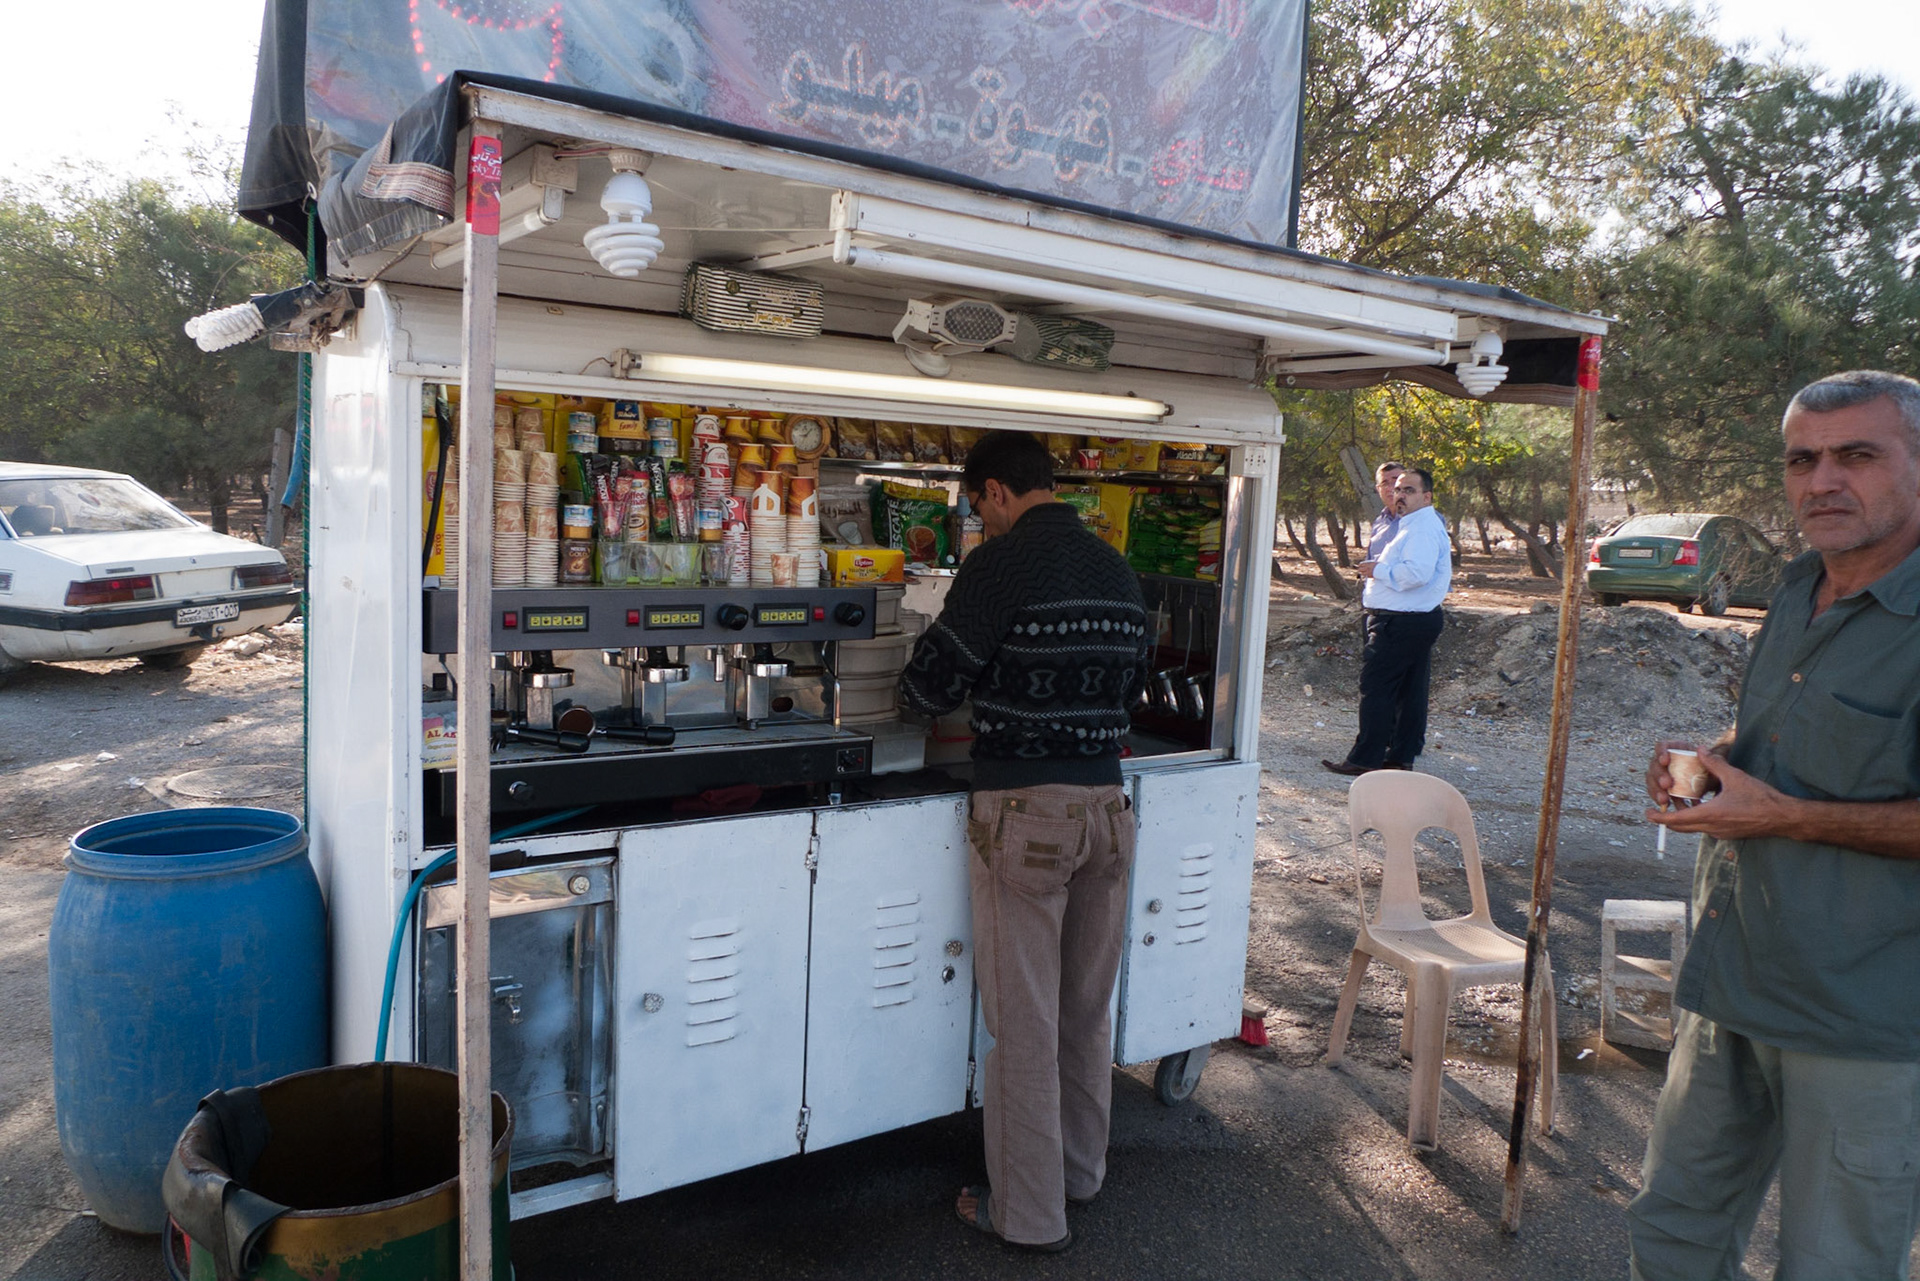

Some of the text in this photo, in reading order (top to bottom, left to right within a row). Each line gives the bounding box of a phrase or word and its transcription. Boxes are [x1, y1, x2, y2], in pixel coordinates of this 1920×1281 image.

[768, 42, 1251, 203] شاي قهوة ميلو
[887, 499, 903, 549] ESCAFÉ
[855, 560, 873, 568] Lipton
[179, 609, 201, 617] دمشق
